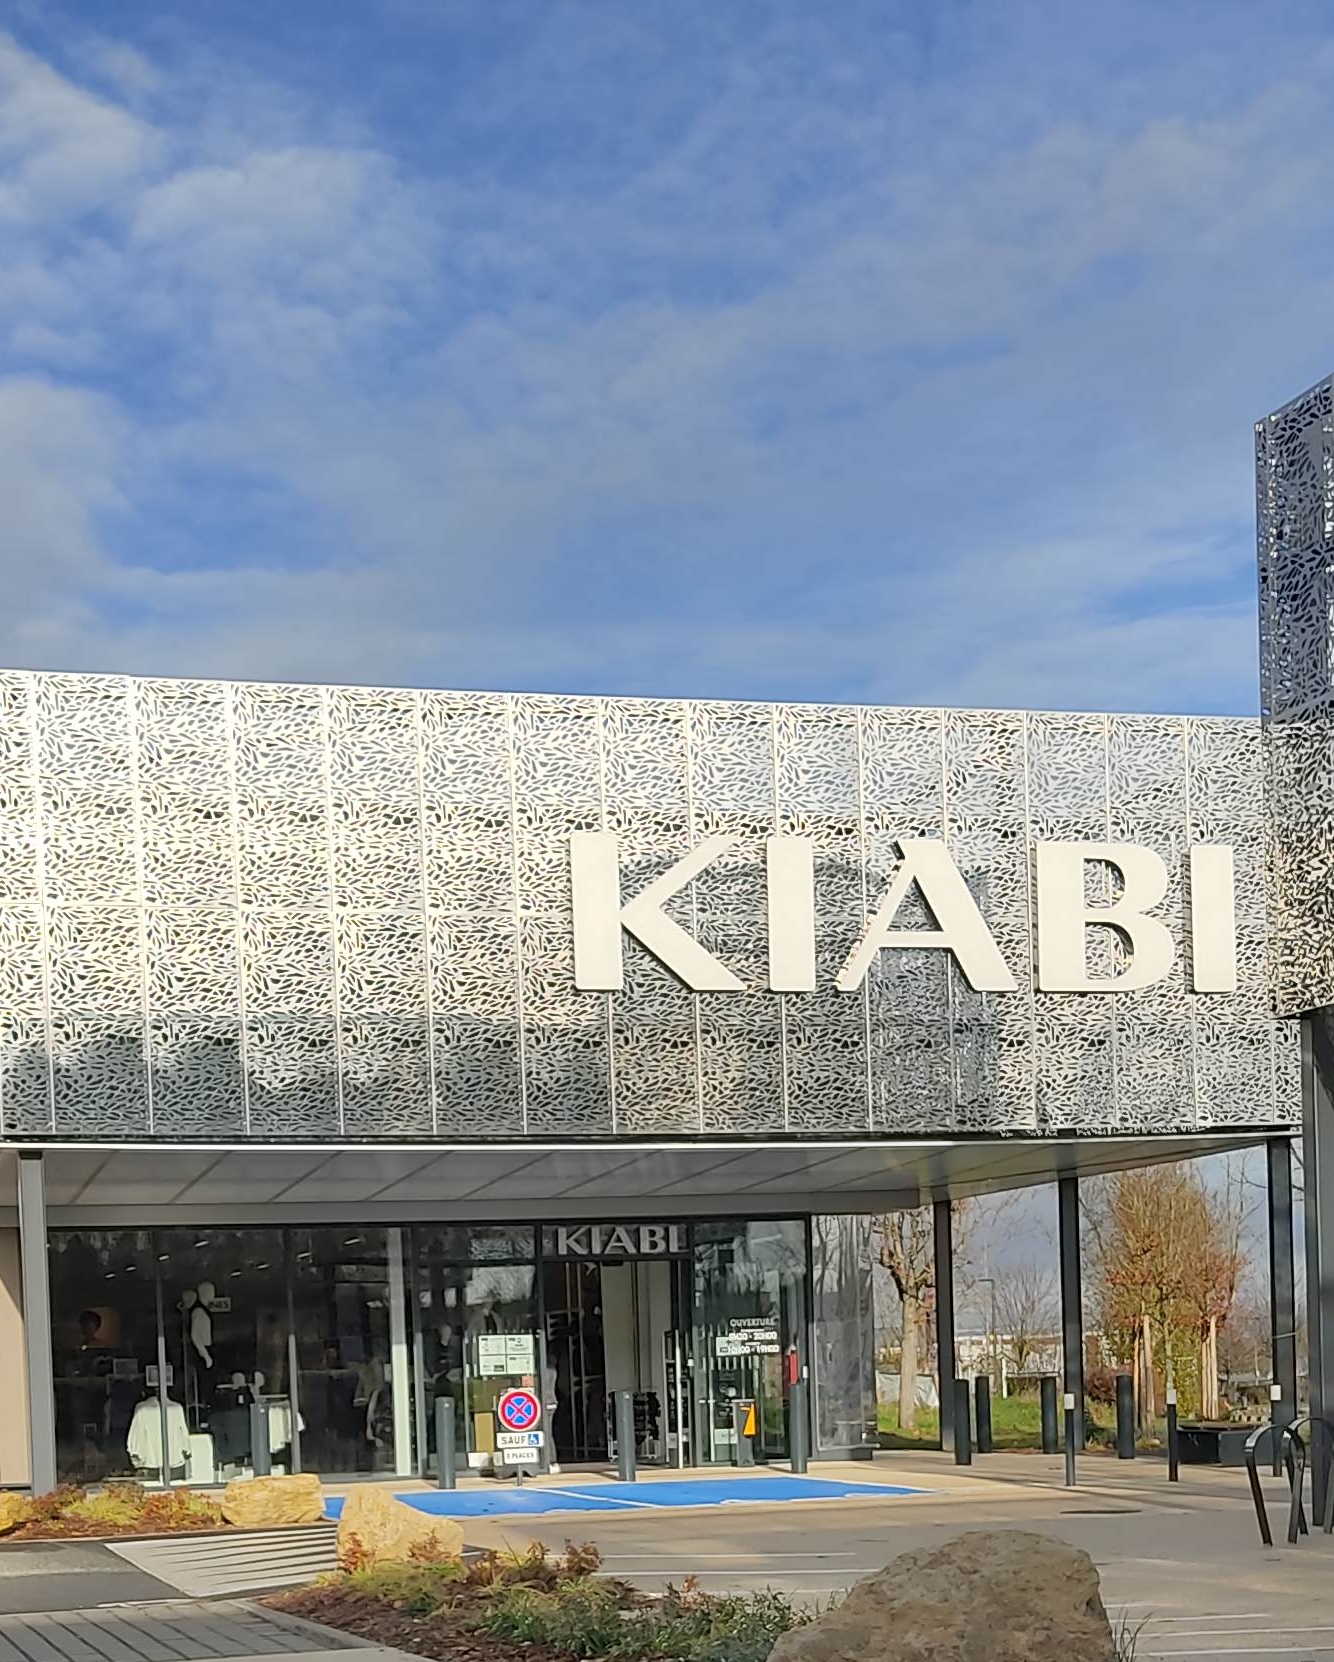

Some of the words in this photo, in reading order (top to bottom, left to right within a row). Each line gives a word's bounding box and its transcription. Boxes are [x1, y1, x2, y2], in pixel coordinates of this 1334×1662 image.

[570, 832, 1237, 993] KIABI
[557, 1224, 679, 1255] KIABI
[501, 1435, 527, 1445] SAUF
